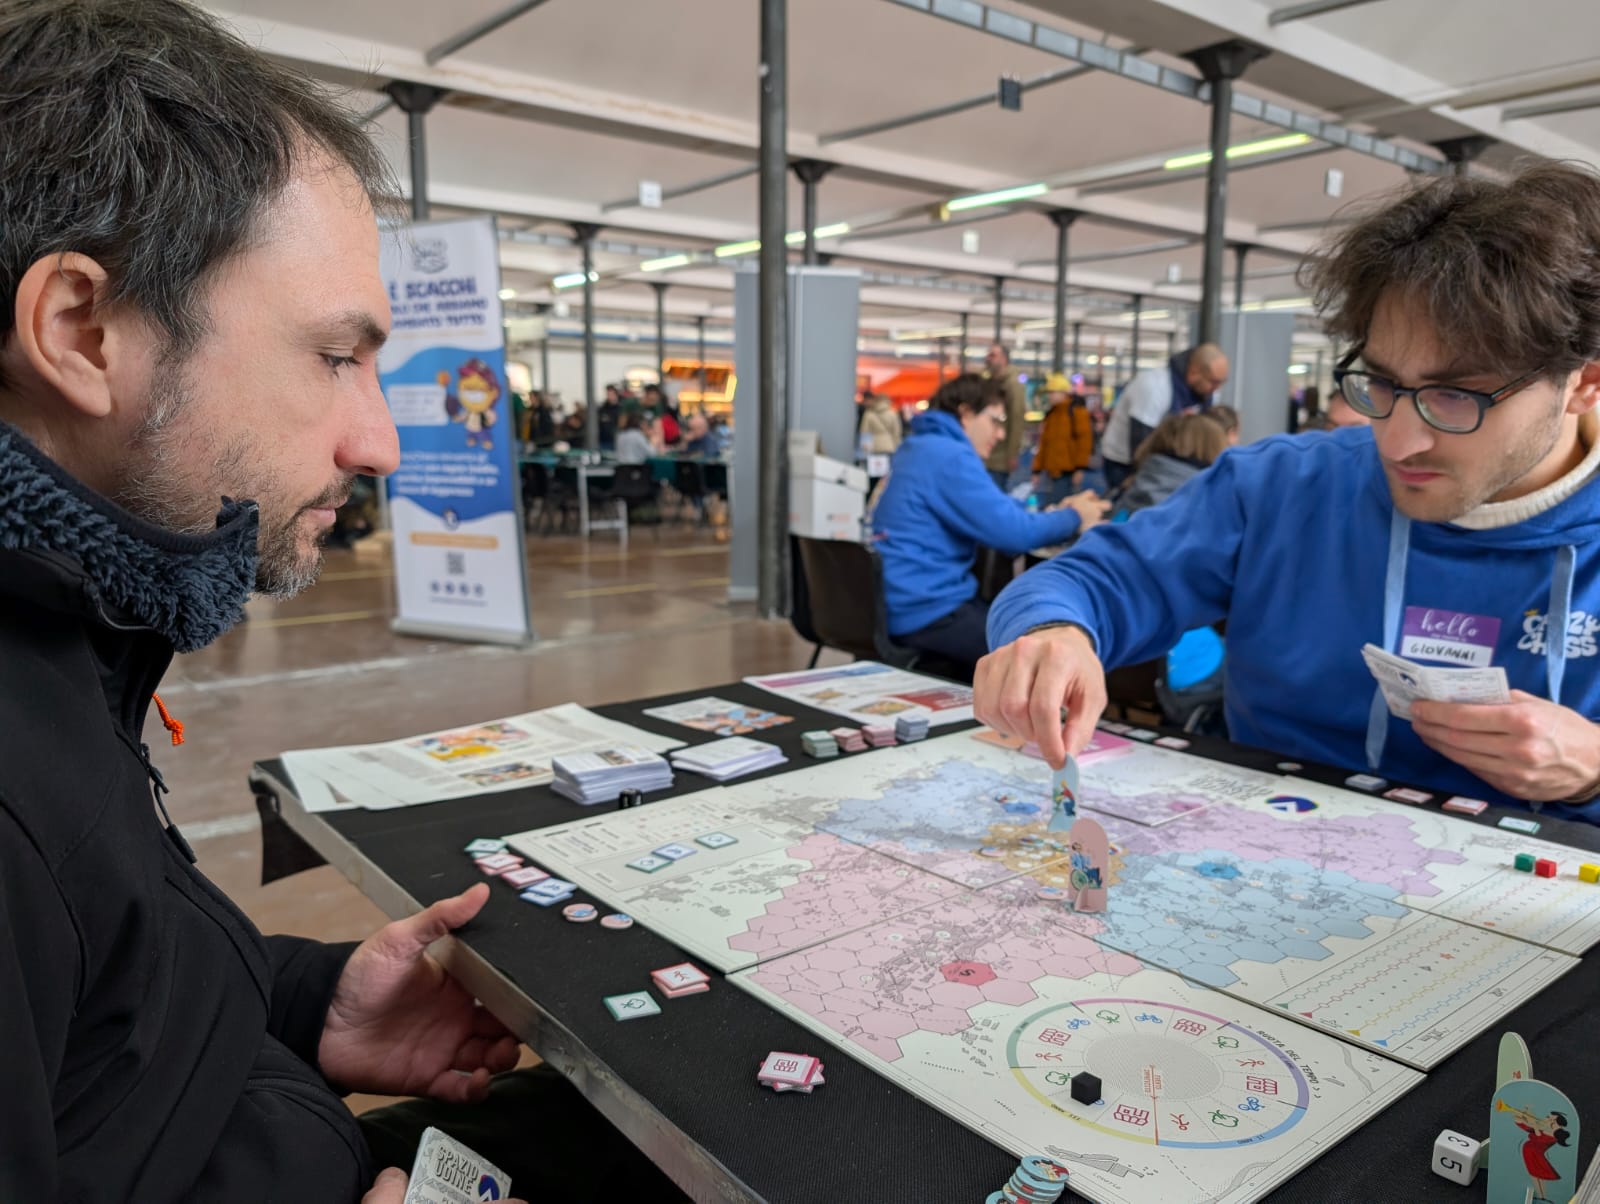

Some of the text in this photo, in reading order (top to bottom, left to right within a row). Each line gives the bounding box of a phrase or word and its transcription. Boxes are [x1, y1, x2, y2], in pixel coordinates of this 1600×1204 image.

[406, 277, 476, 300] SCACCHI
[1421, 609, 1479, 637] hello
[1410, 643, 1475, 660] GIOVANNI
[1517, 633, 1598, 658] CHSS
[1256, 1030, 1319, 1084] RUOTA DEL TEMPO
[1448, 1136, 1470, 1147] 3
[438, 1145, 479, 1181] SPAZIO
[1440, 1157, 1462, 1173] 5
[436, 1160, 473, 1195] UDINE
